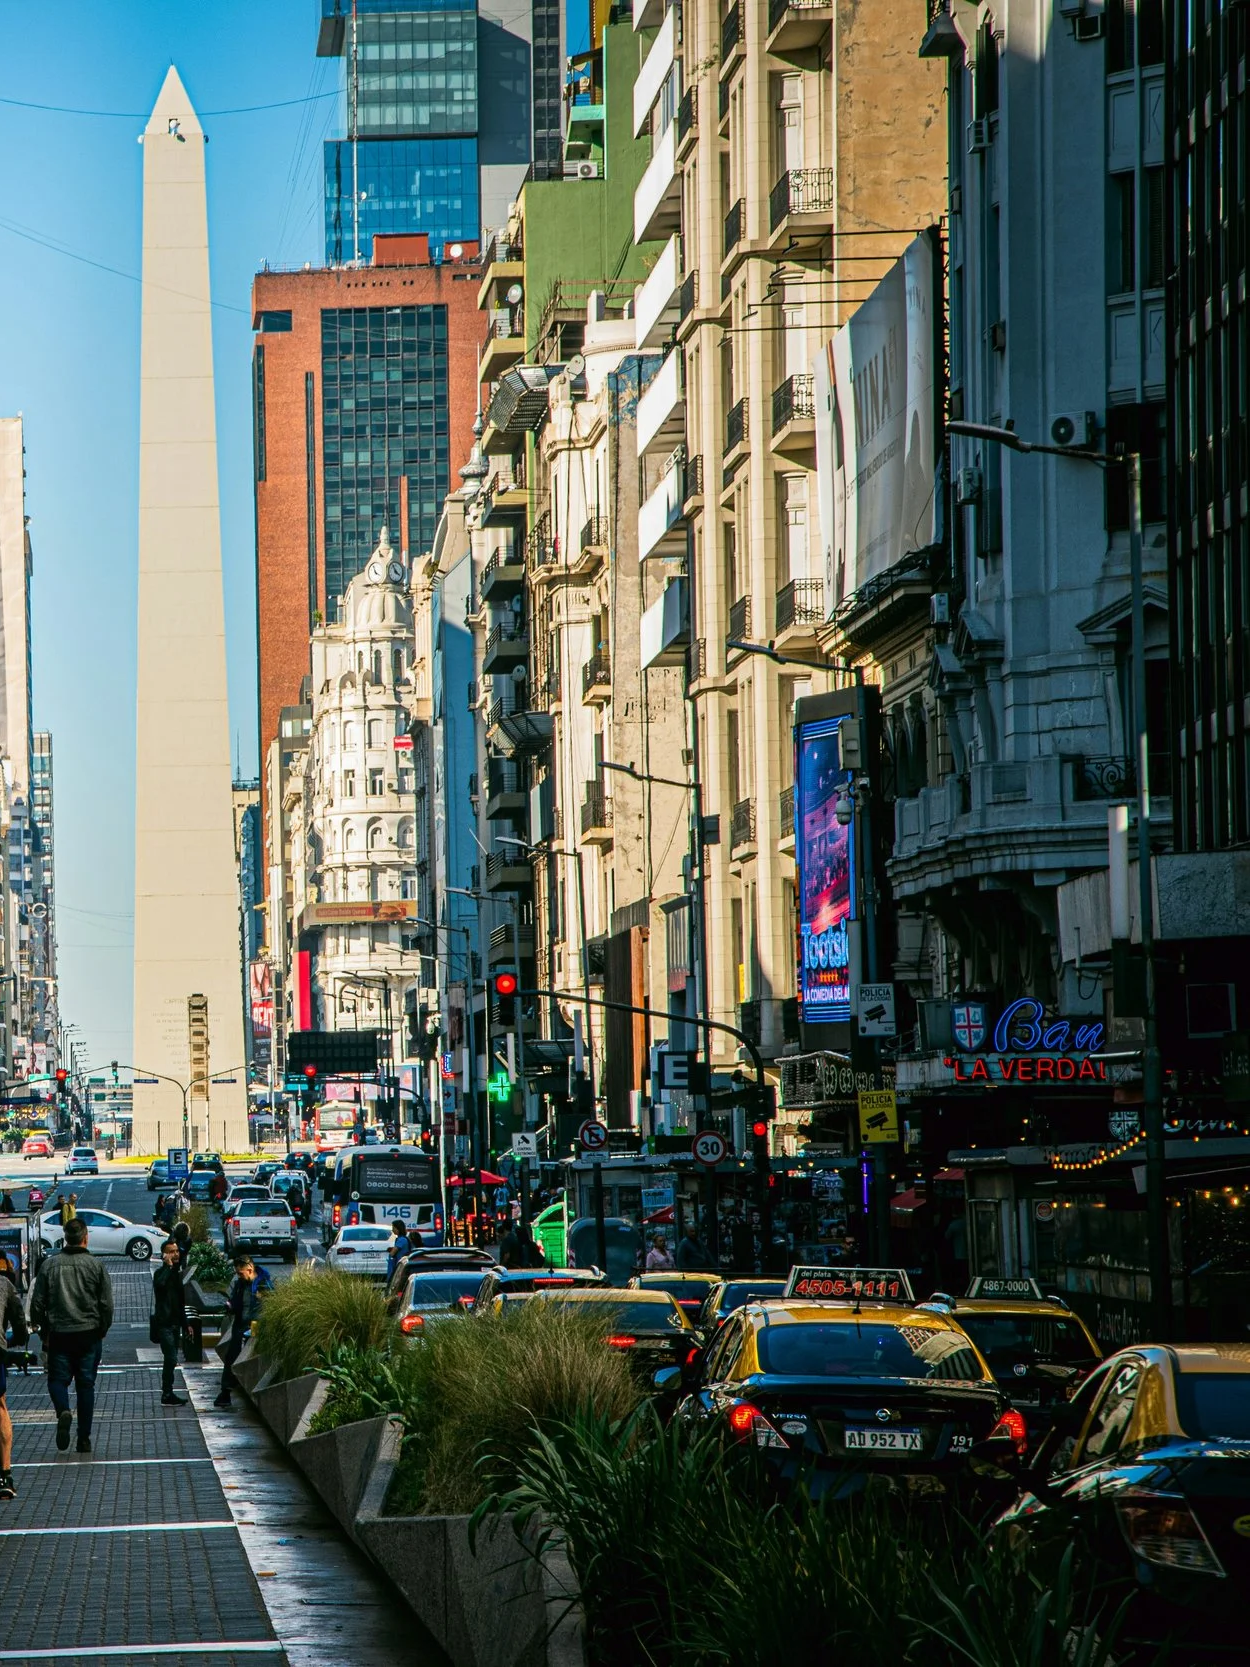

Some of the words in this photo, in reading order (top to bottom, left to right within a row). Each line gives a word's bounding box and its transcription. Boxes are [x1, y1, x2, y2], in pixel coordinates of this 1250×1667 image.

[803, 917, 849, 968] Tootsi
[860, 988, 891, 997] POLICIA
[861, 1095, 892, 1105] POLICIA
[700, 1141, 720, 1155] 30
[174, 1152, 183, 1164] E
[382, 1206, 411, 1218] 146
[814, 1271, 832, 1279] plata
[795, 1279, 900, 1297] 4505-1111
[983, 1280, 1029, 1291] 4867-0000
[849, 1433, 866, 1447] AD
[870, 1433, 896, 1447] 952
[902, 1434, 920, 1448] TX
[952, 1435, 974, 1447] 191
